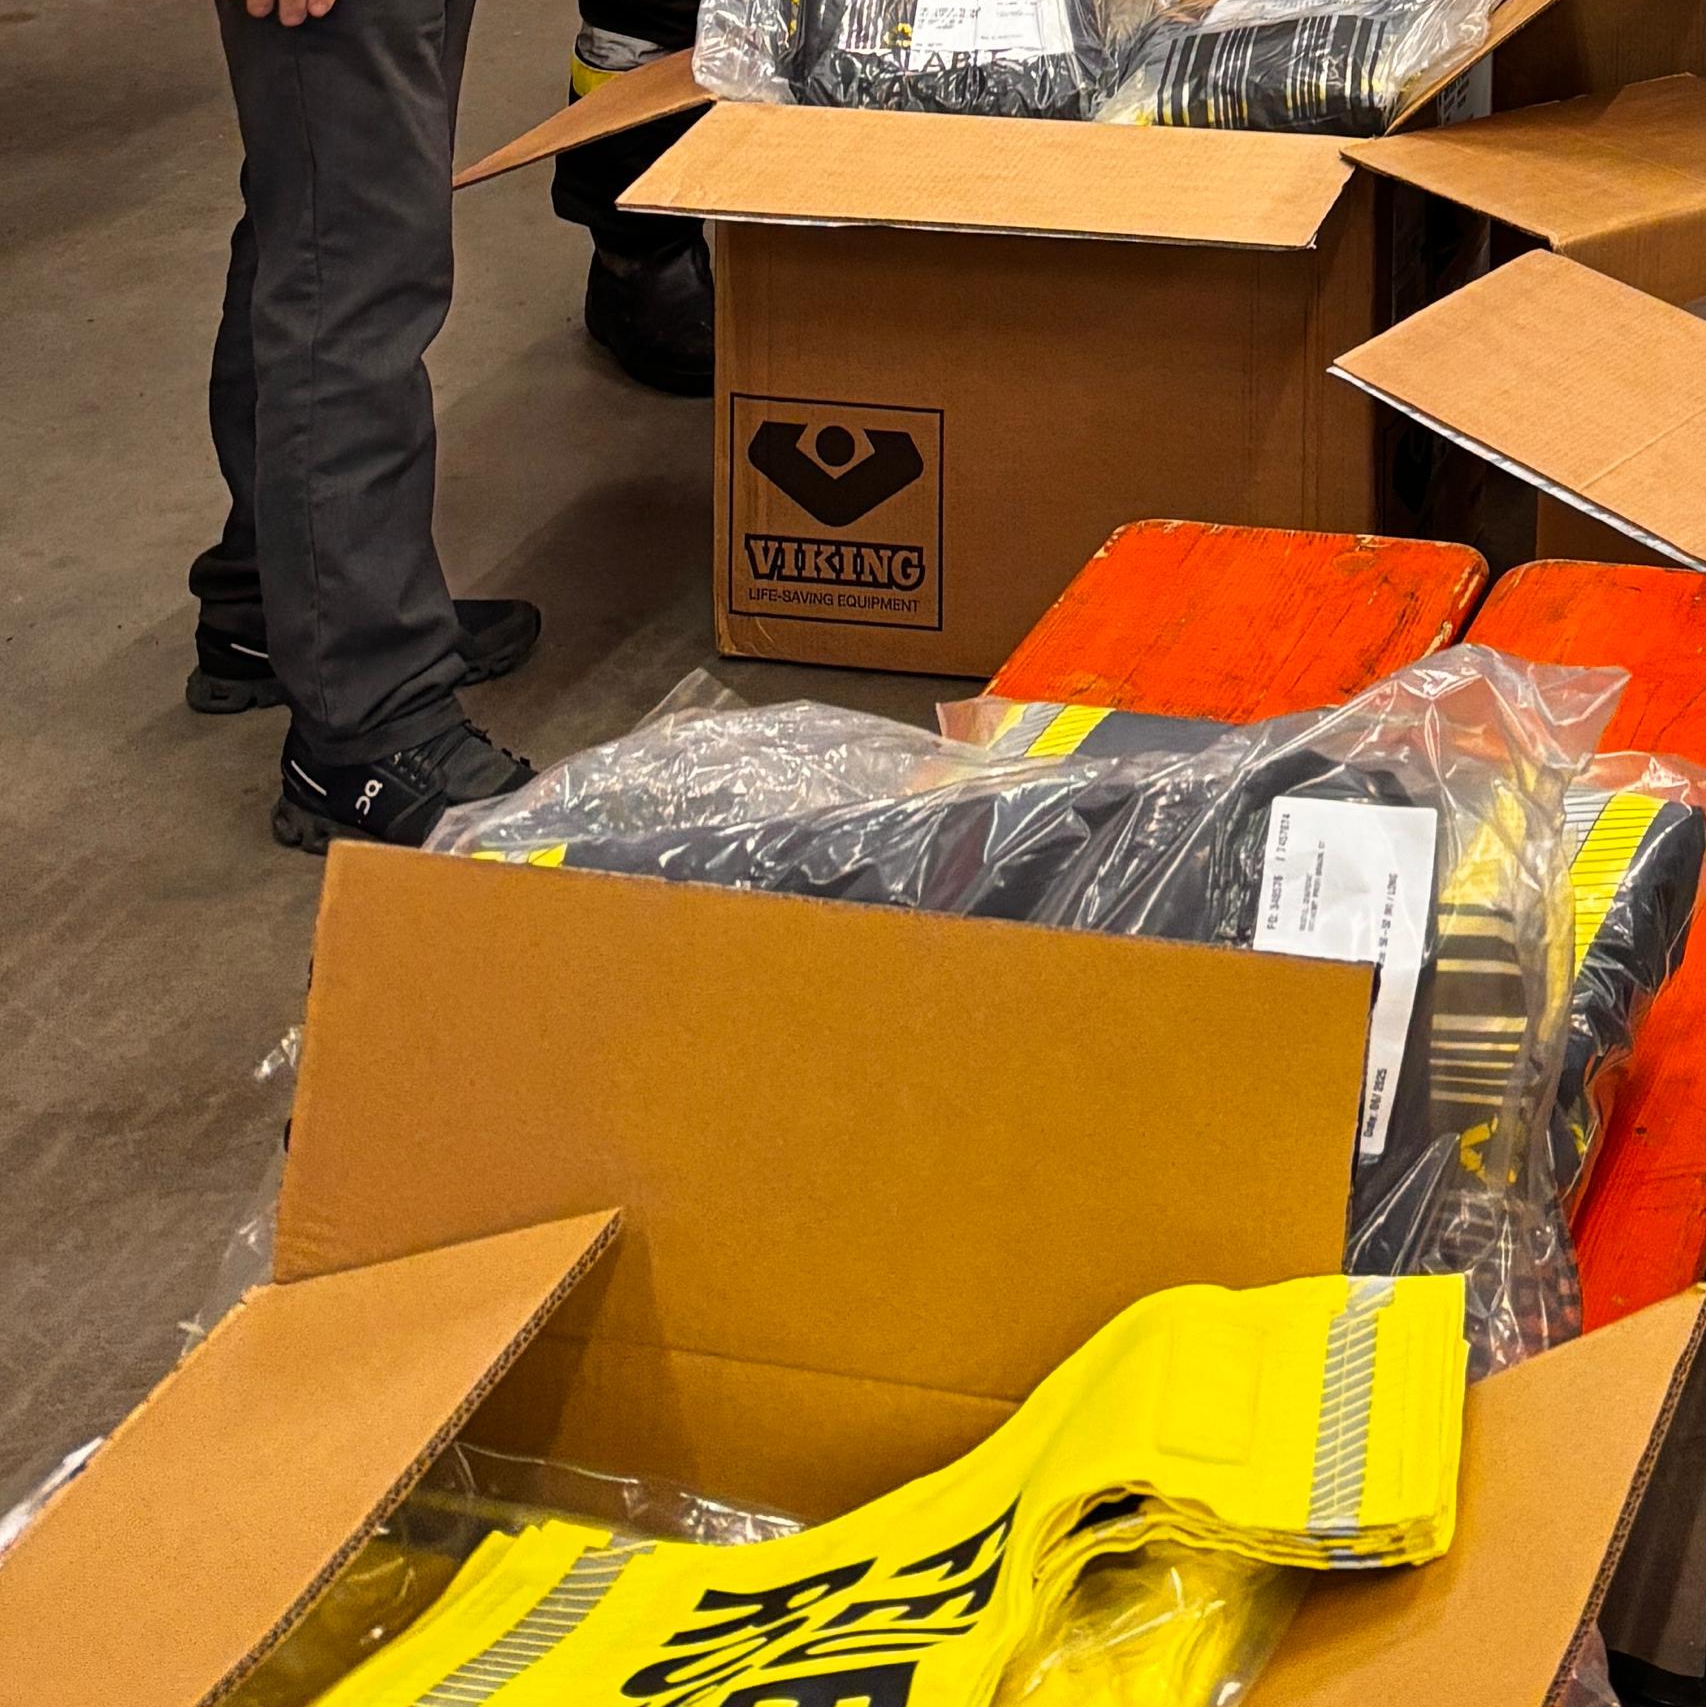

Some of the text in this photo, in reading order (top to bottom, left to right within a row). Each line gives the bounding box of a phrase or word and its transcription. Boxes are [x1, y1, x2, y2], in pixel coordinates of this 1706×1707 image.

[746, 535, 925, 591] VIKING
[748, 588, 921, 612] LIFE-SAVING EQUIPMENT
